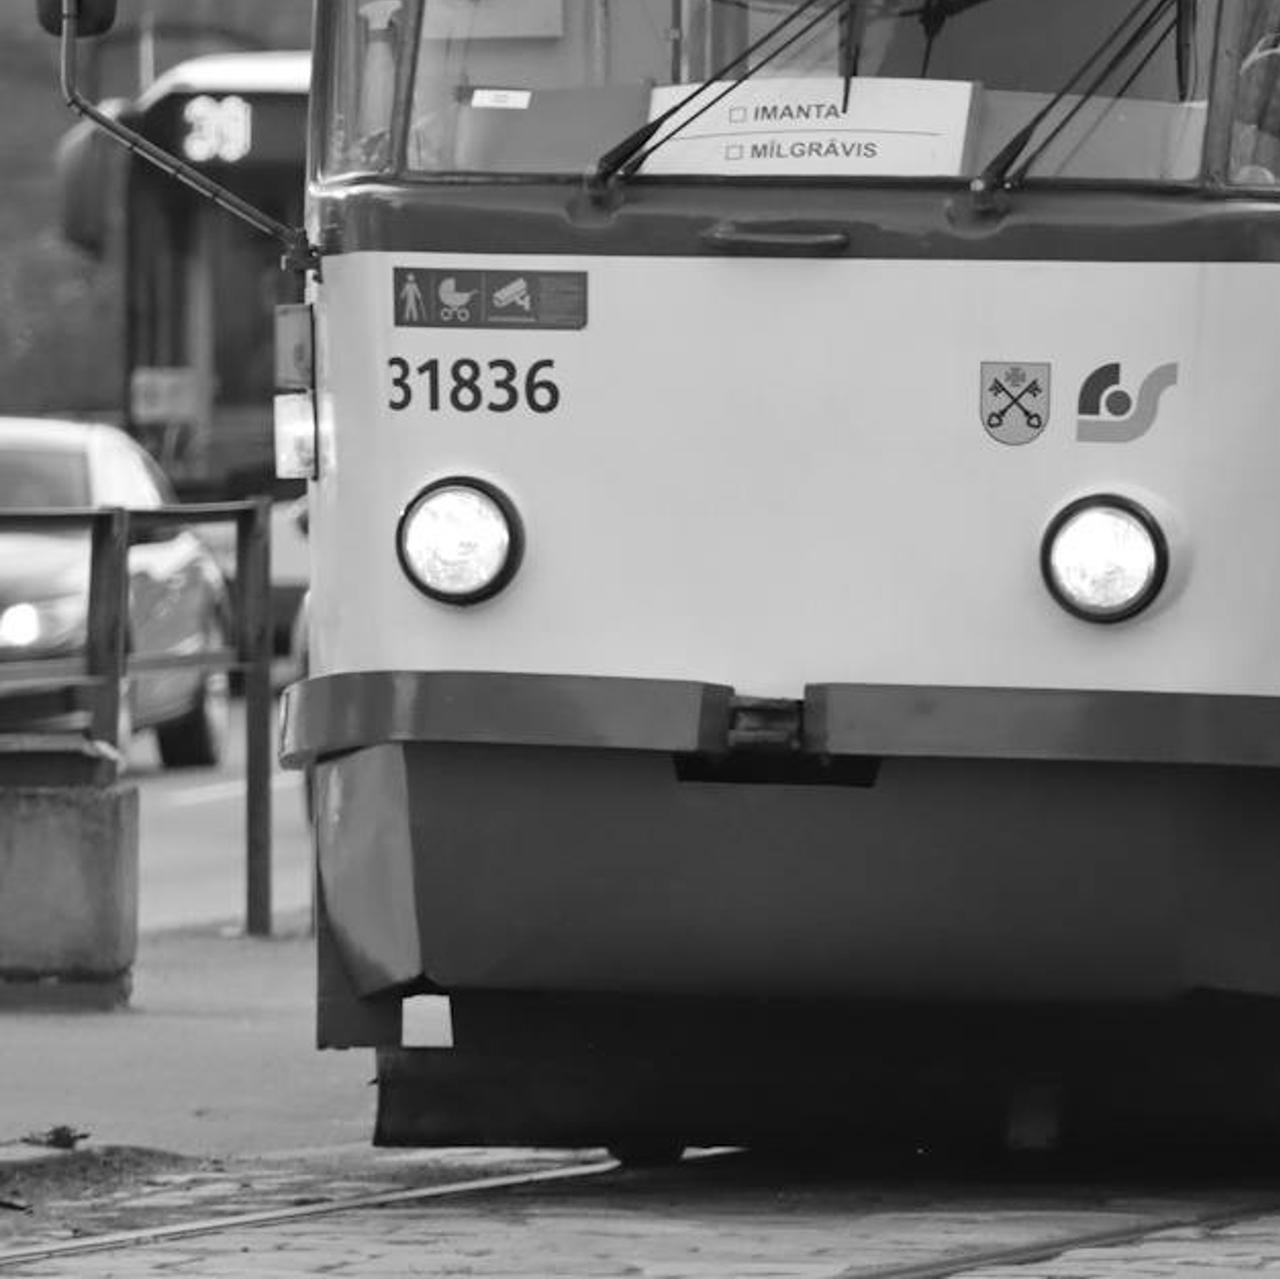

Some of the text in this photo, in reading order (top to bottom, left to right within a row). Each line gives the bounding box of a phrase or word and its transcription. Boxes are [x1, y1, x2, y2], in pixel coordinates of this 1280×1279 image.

[754, 104, 841, 121] IMANTA
[750, 139, 878, 160] MĪLGRĀVIS
[388, 356, 560, 414] 31836
